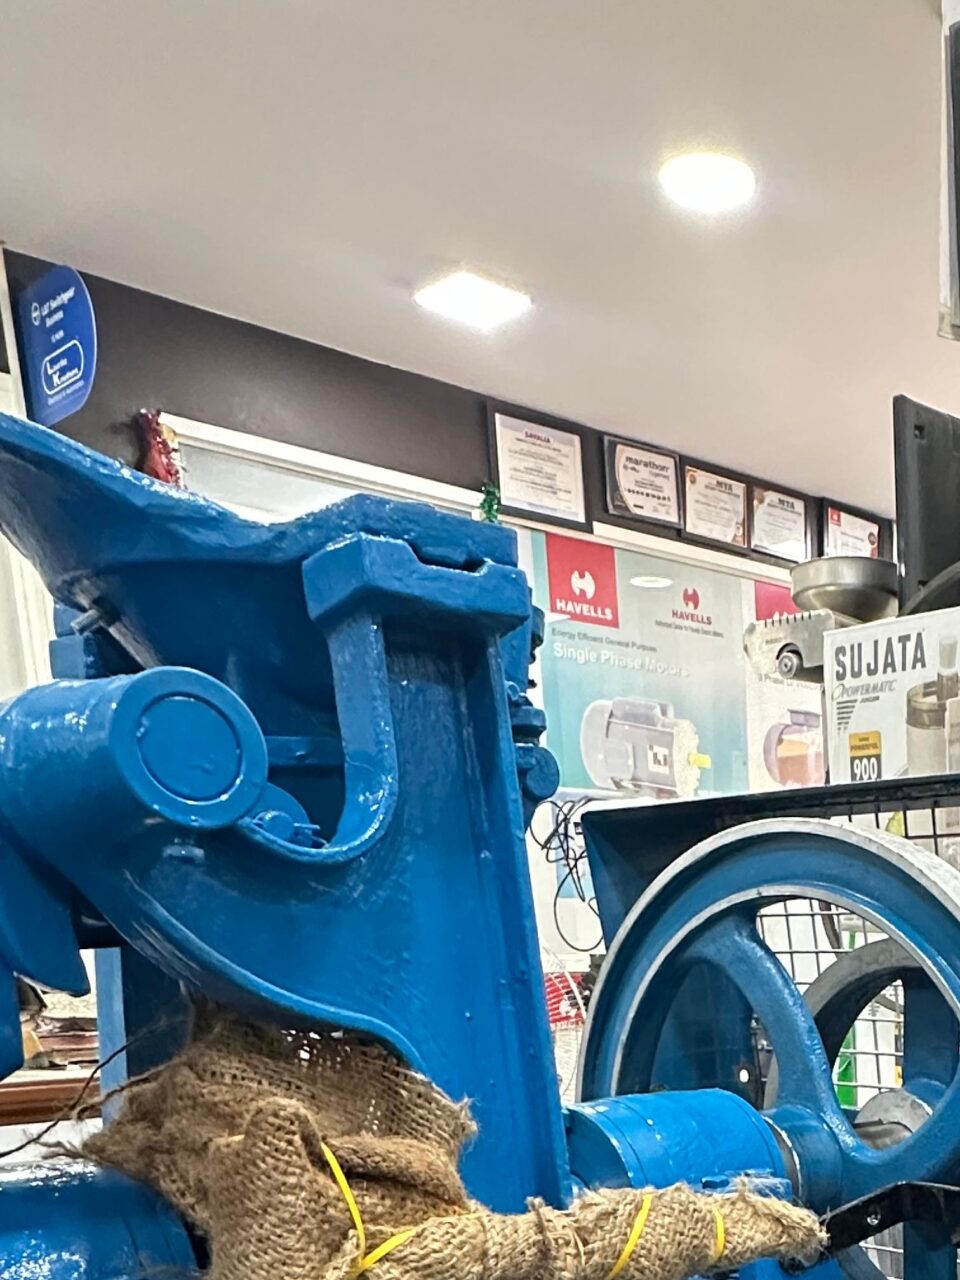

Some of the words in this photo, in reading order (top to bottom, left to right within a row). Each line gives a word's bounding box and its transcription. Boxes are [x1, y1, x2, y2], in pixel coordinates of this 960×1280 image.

[556, 599, 613, 621] HAVELLS
[671, 609, 713, 626] HAVELLS
[553, 642, 597, 664] Single
[601, 650, 642, 670] Phase
[835, 632, 927, 682] SUJATA
[854, 757, 877, 781] 900
